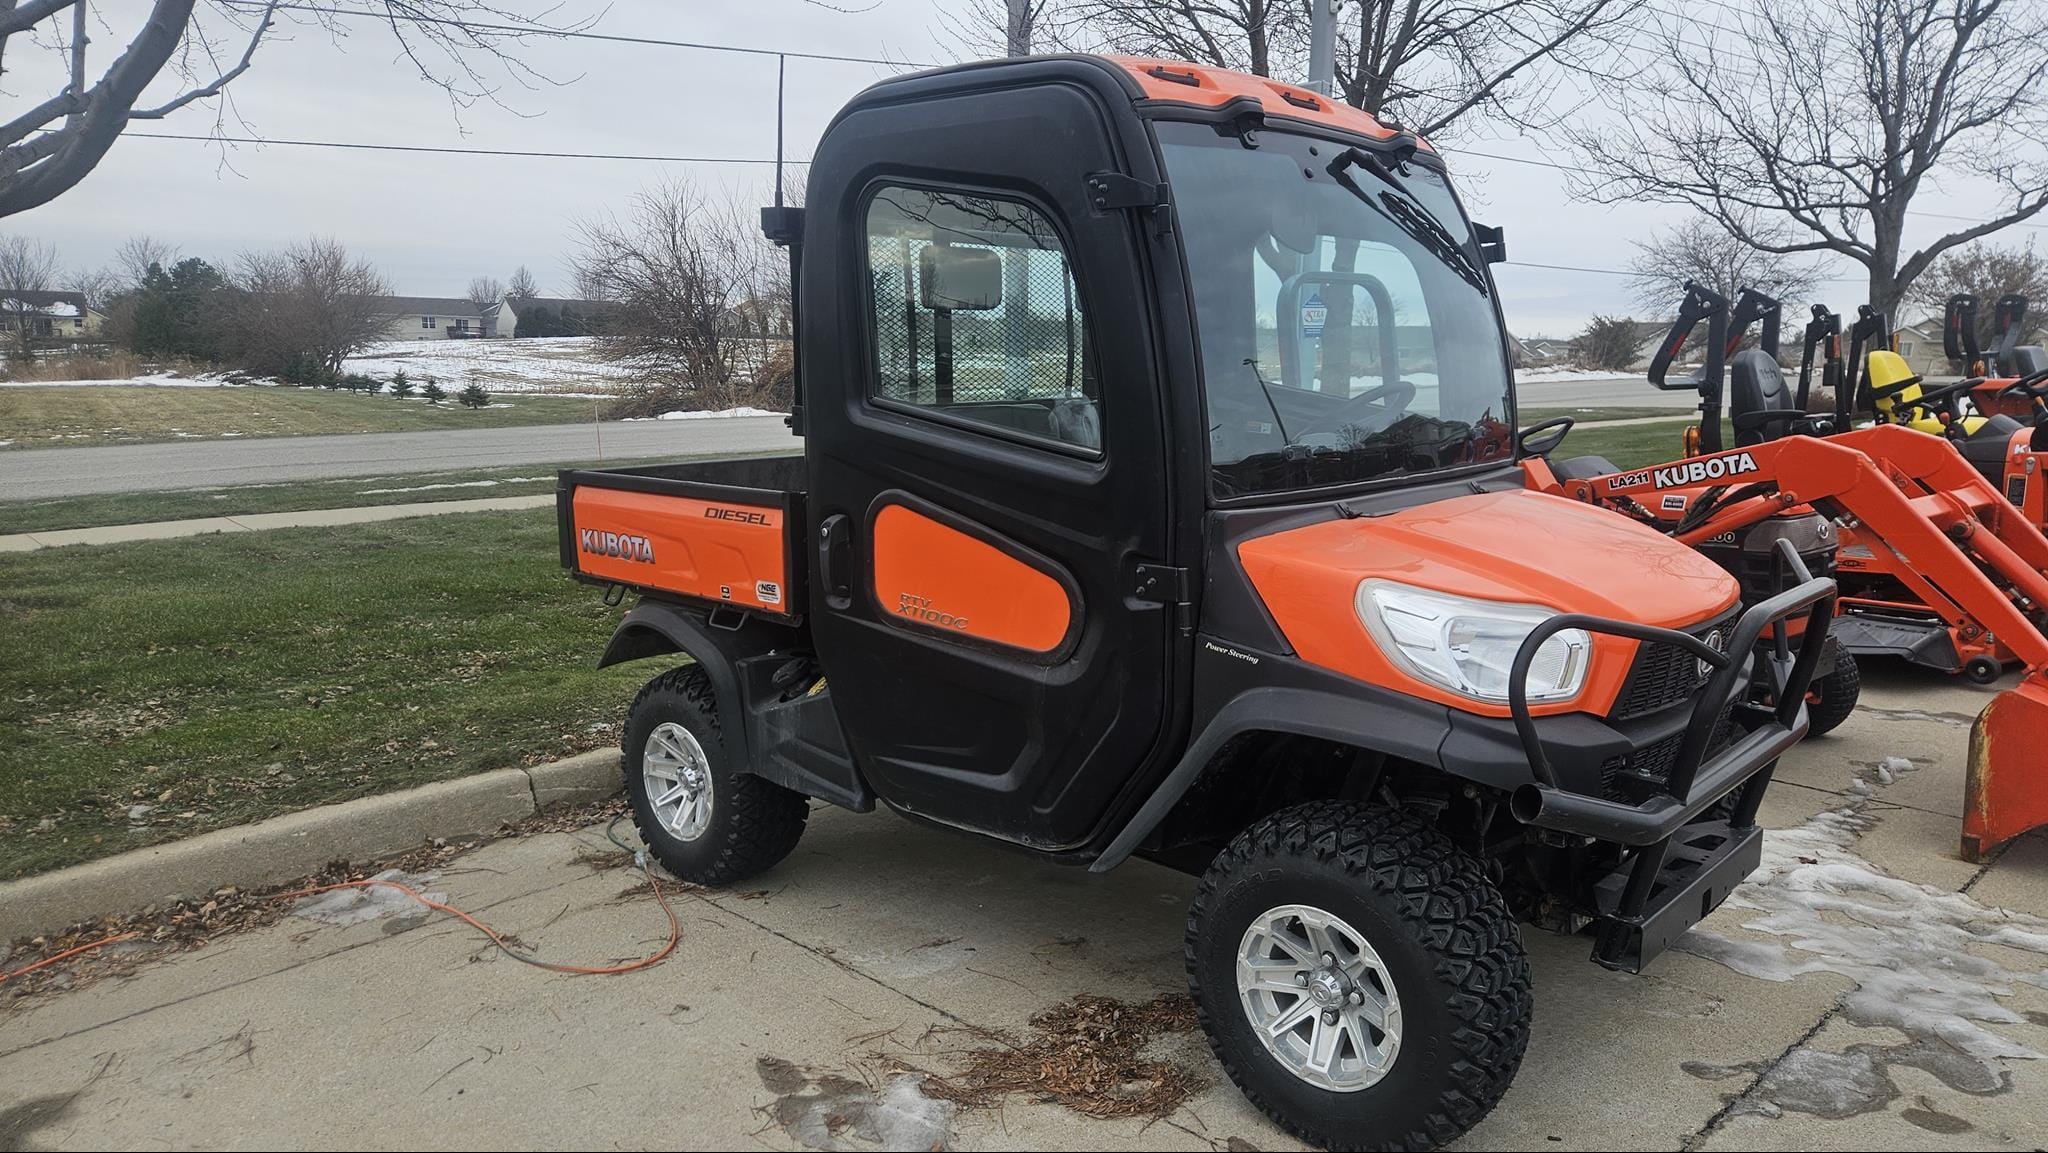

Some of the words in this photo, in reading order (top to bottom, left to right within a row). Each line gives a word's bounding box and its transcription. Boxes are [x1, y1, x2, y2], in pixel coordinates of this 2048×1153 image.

[1608, 473, 1649, 491] LA211
[1654, 452, 1758, 489] KUBOTA
[703, 507, 772, 526] DIESEL
[581, 528, 656, 564] KUBOTA
[901, 592, 932, 607] RTV
[1206, 641, 1228, 653] Power
[1228, 648, 1259, 664] Steering
